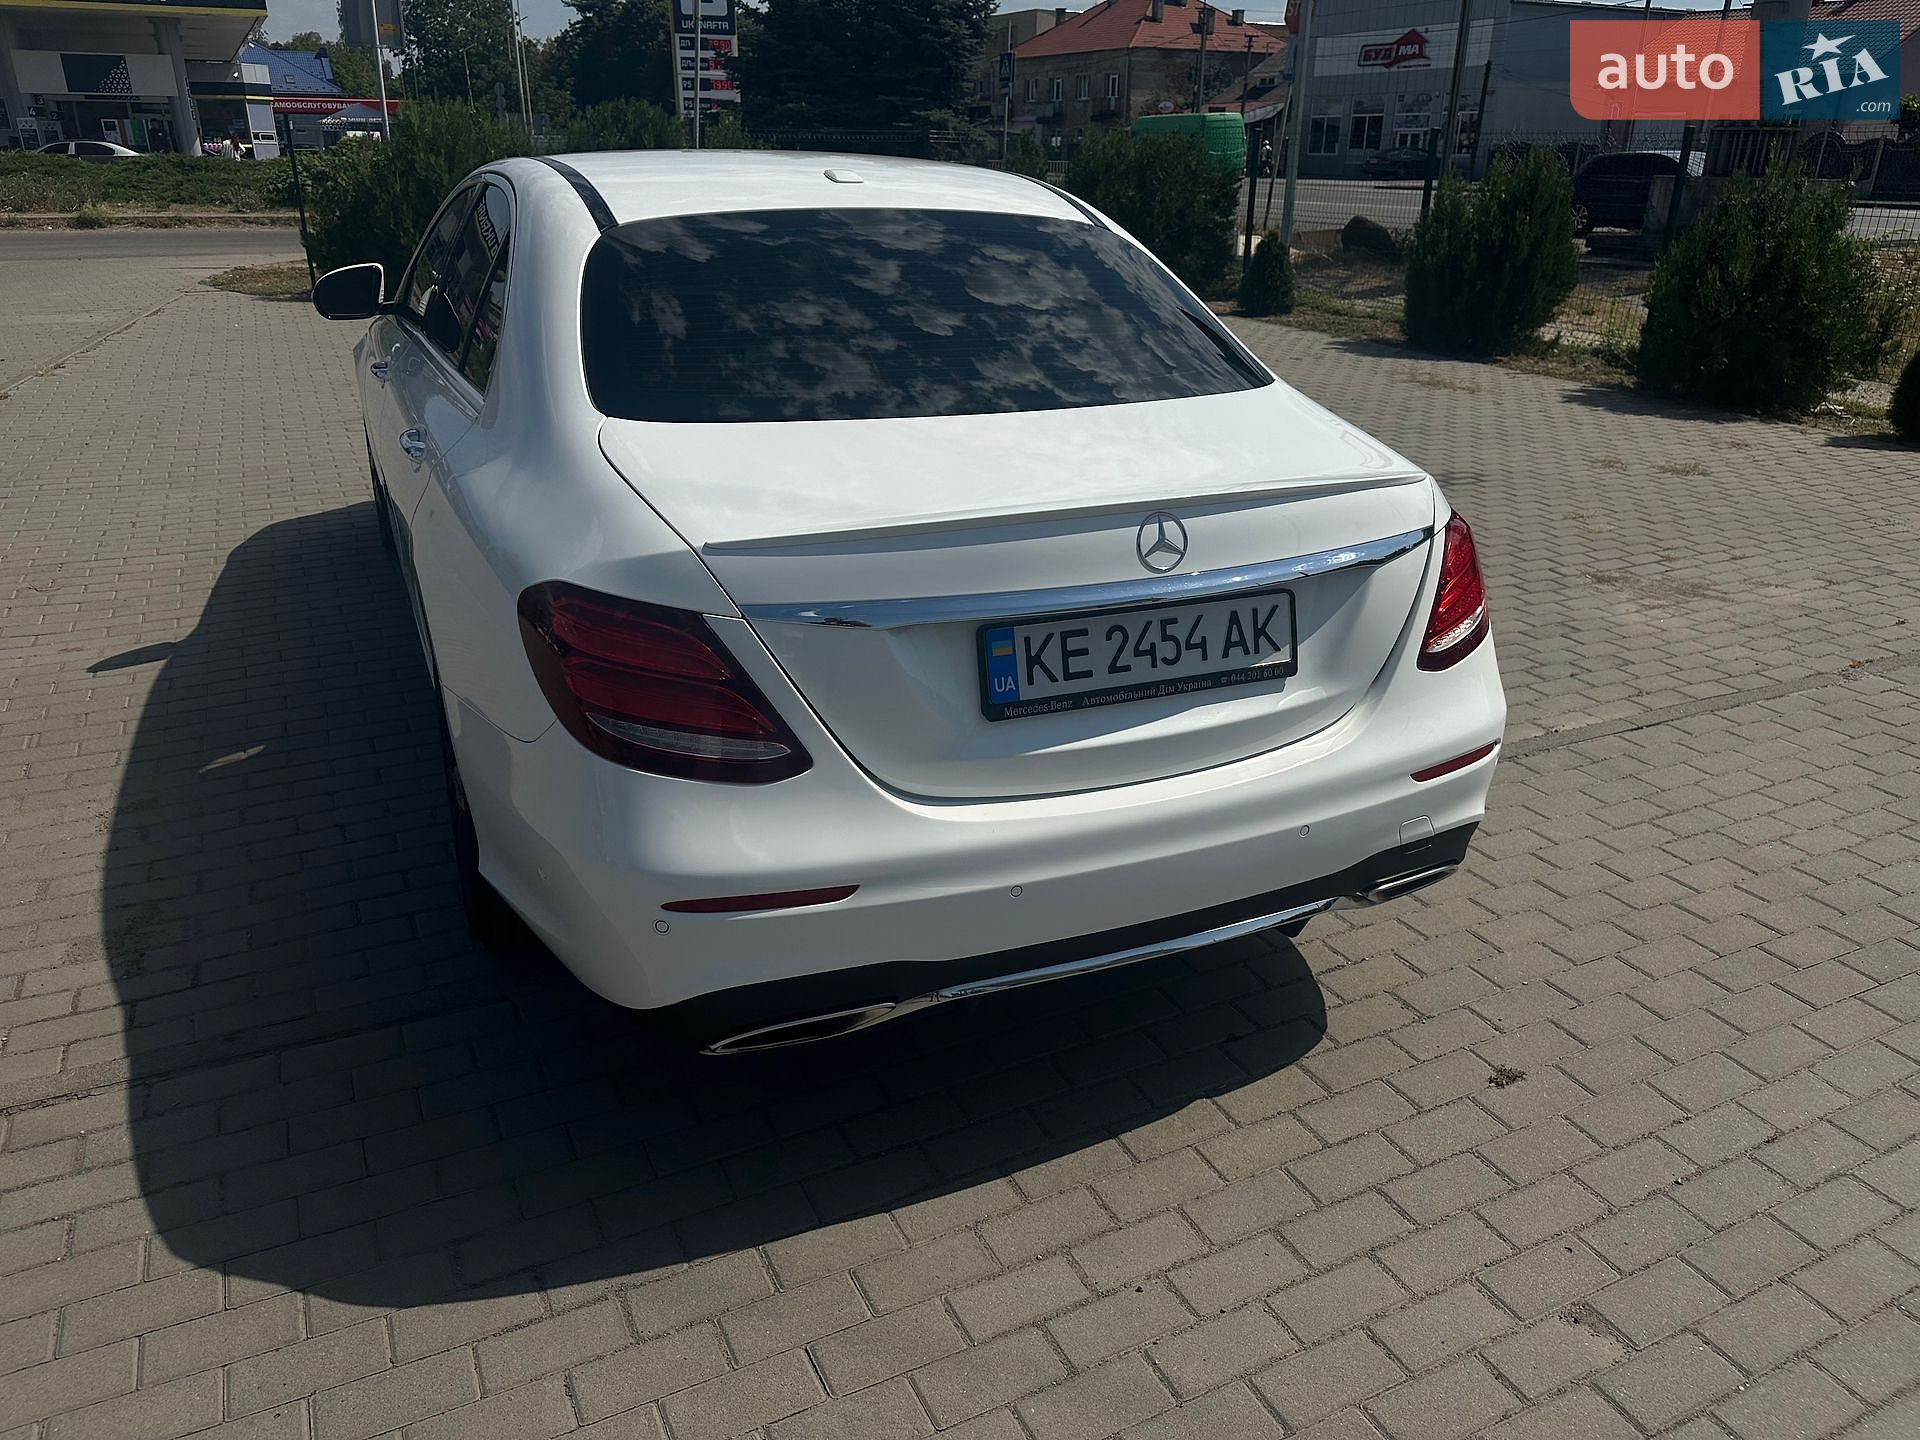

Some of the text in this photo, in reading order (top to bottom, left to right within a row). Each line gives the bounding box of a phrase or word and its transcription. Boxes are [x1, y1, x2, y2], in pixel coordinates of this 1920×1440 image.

[681, 19, 729, 30] UKNAFTA
[1023, 604, 1282, 686] KE 2454 AK
[994, 676, 1016, 692] UA
[1004, 700, 1073, 717] Mercedes-Benz
[1158, 684, 1175, 696] Дім
[1176, 680, 1212, 692] Україна
